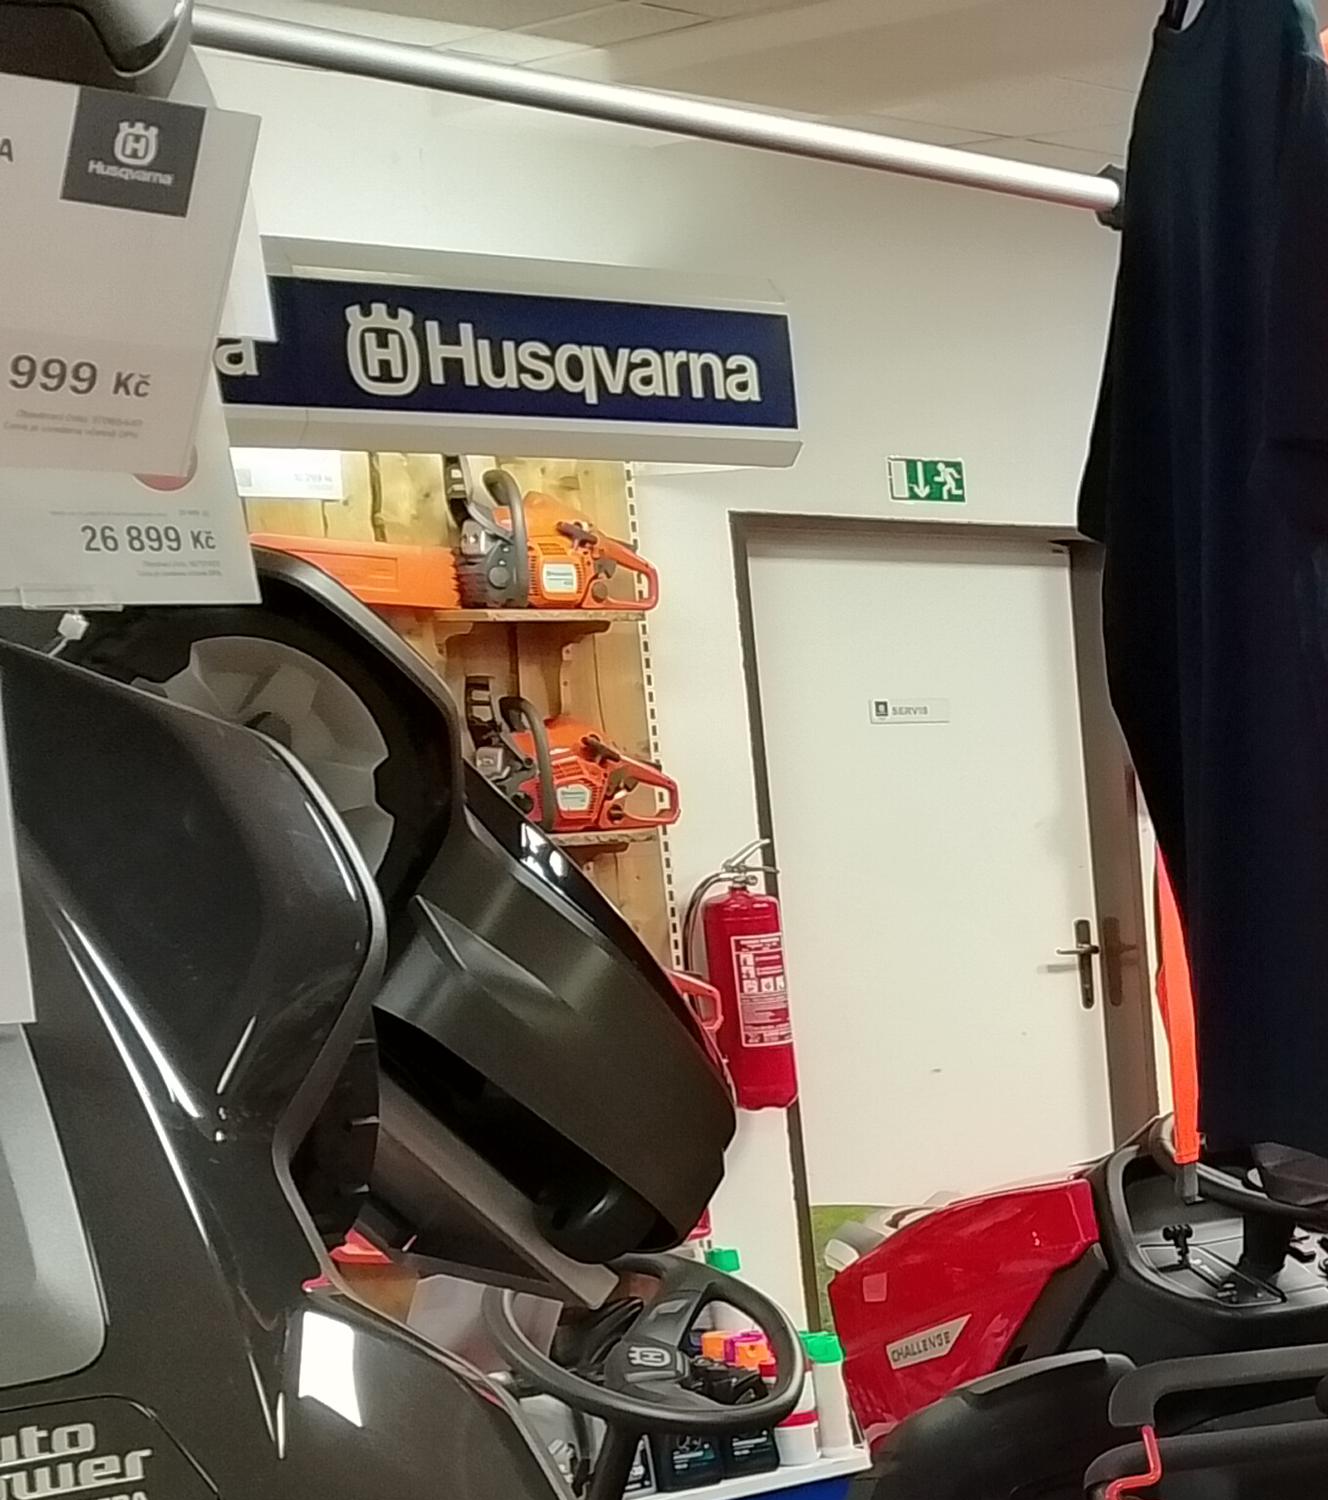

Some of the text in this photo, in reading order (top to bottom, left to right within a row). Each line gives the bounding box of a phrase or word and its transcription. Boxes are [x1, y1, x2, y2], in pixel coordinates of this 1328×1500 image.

[88, 160, 174, 186] Husqvarna
[9, 354, 151, 398] 999 Kč
[425, 321, 761, 404] Husqvarna
[81, 525, 217, 551] 26 899 Kč
[891, 1331, 951, 1363] CHALLENGE
